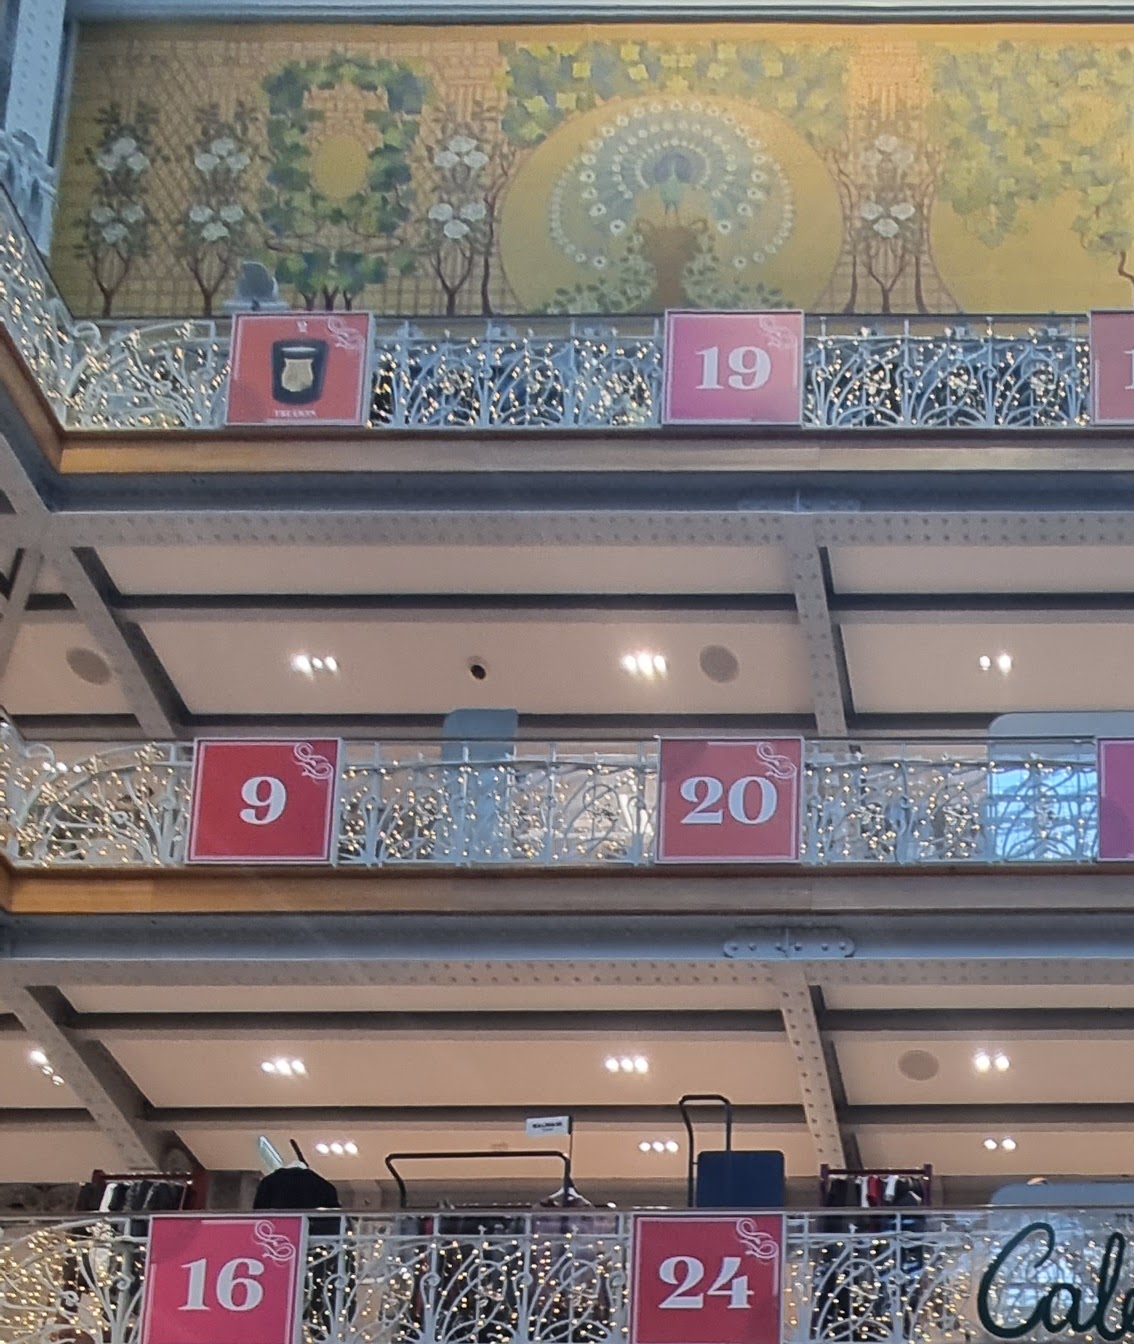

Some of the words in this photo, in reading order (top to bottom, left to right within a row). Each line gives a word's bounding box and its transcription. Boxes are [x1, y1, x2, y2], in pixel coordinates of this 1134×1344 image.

[696, 346, 771, 389] 19
[240, 777, 286, 824] 9
[681, 777, 777, 824] 20
[178, 1258, 264, 1311] 16
[659, 1256, 754, 1308] 24
